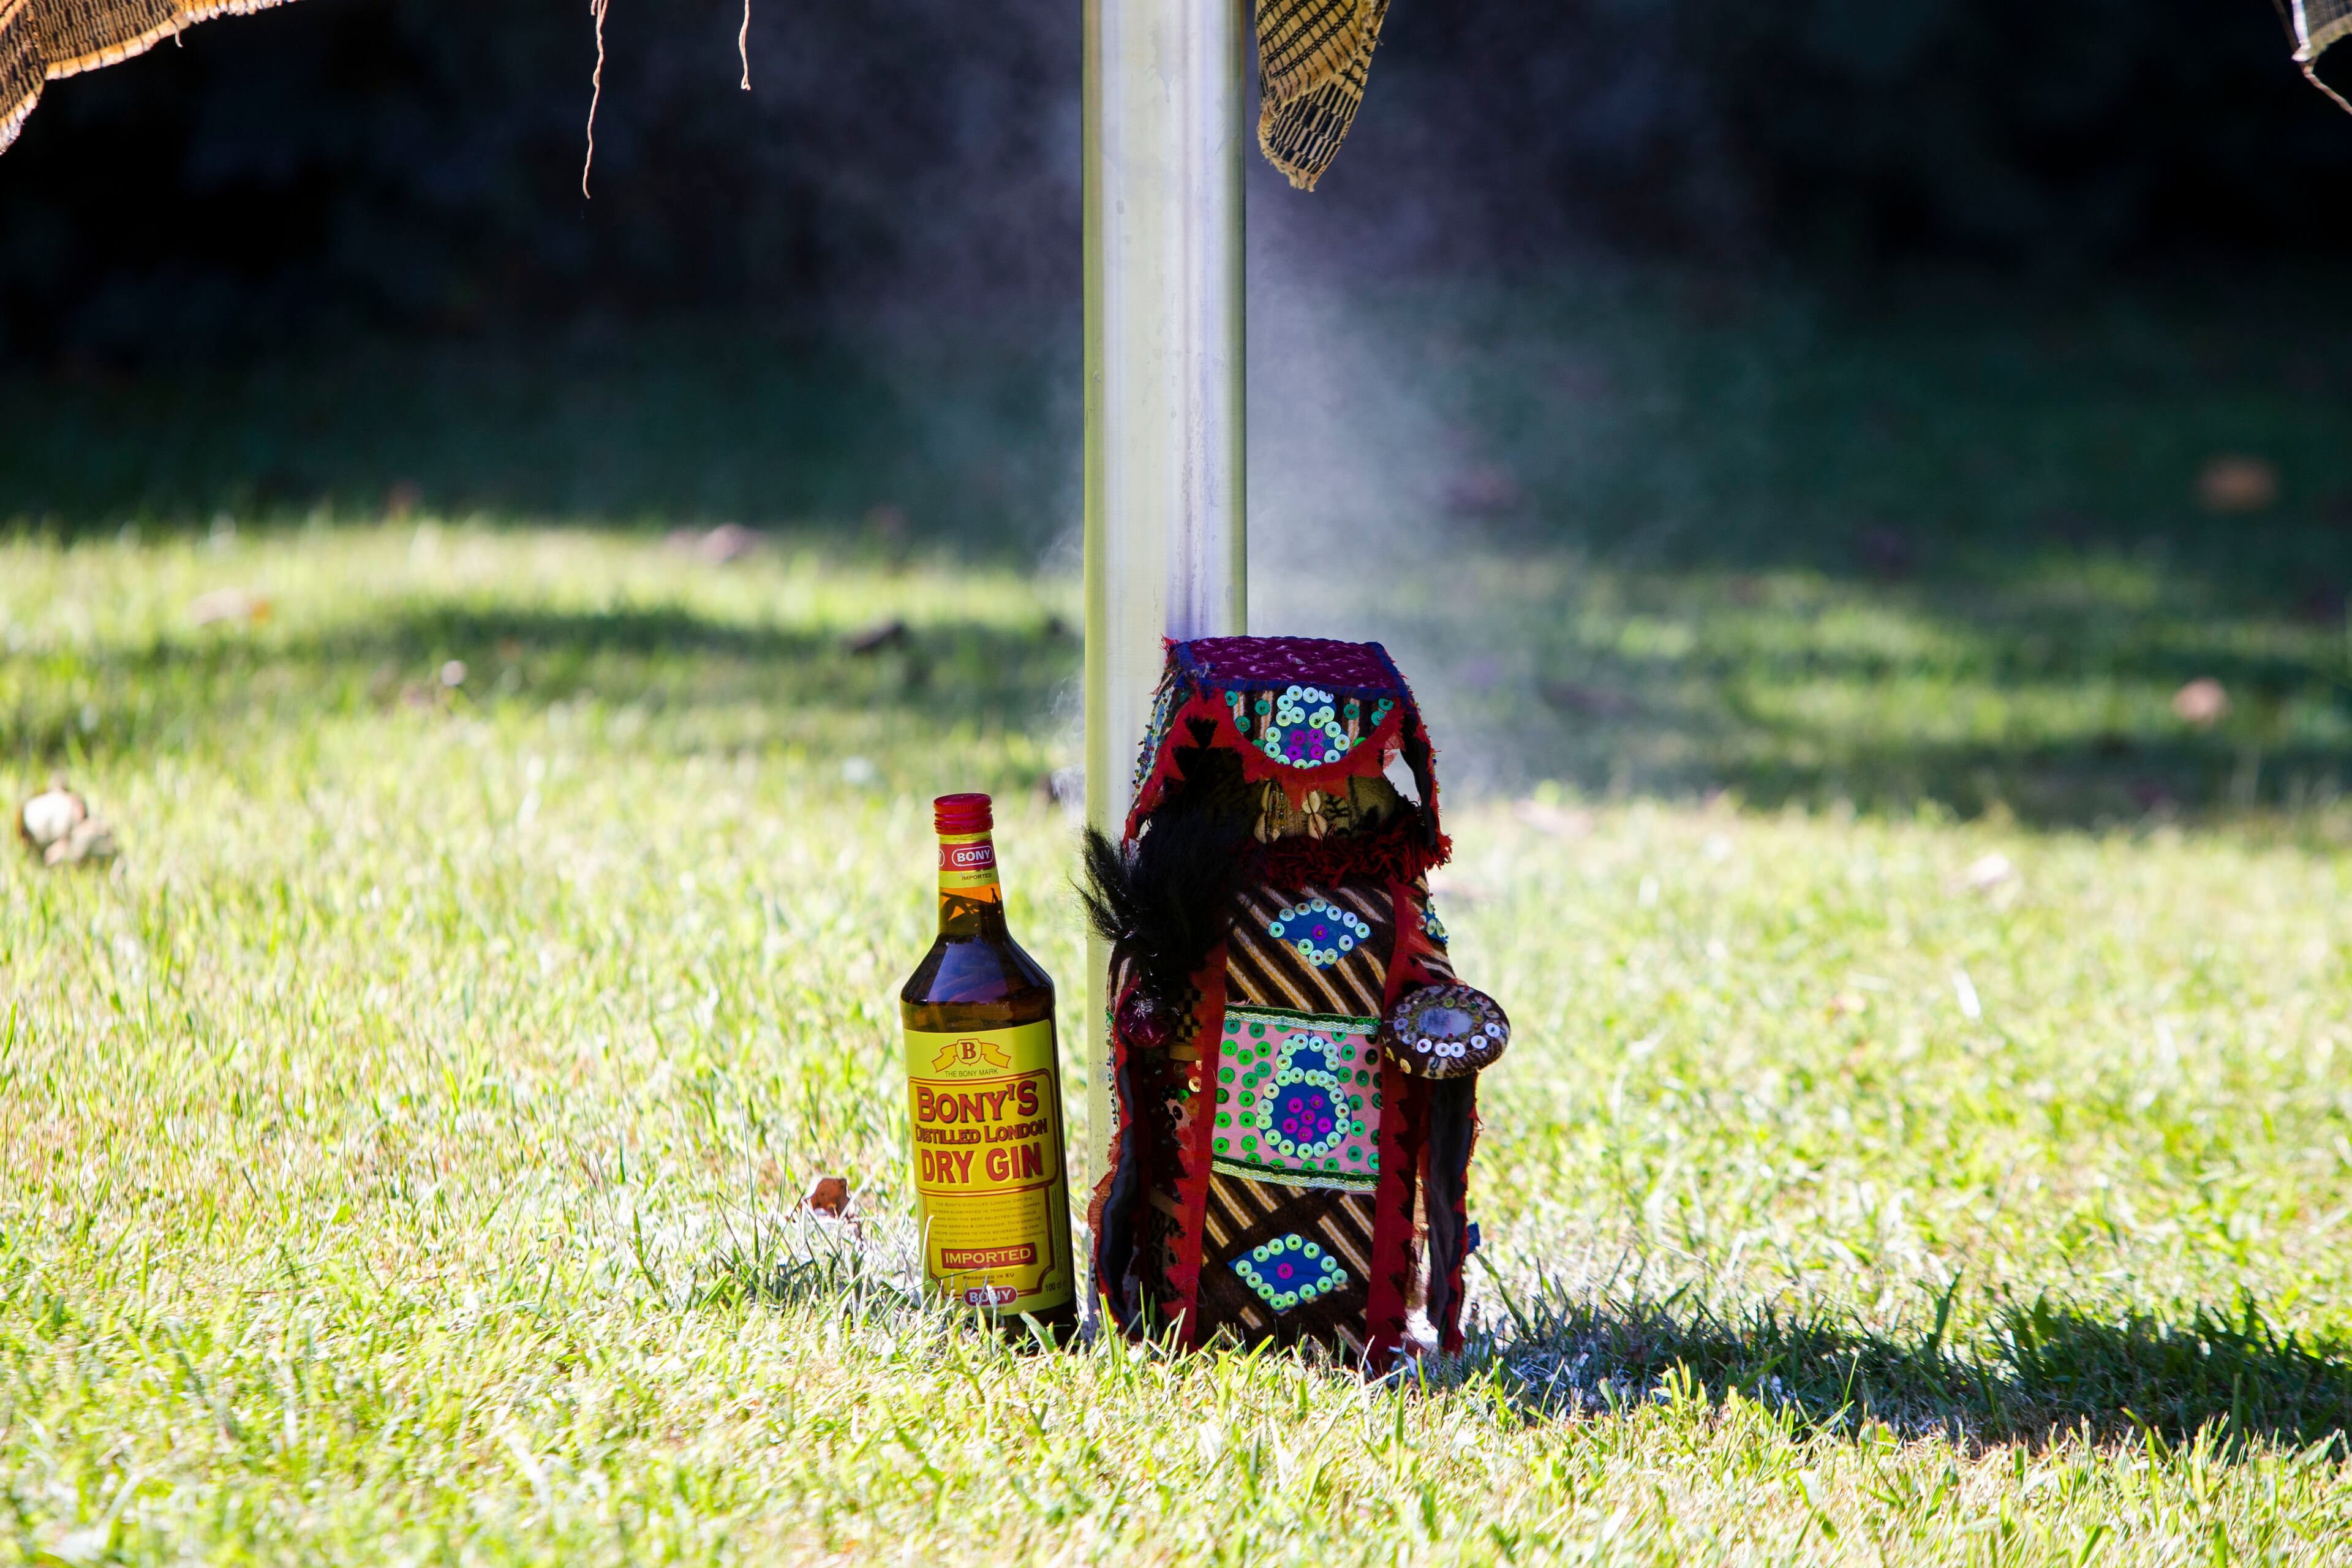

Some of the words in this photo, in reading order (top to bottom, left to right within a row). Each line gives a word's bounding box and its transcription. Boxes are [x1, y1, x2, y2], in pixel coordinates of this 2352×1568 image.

[957, 849, 990, 862] BONY
[960, 1042, 976, 1059] B
[916, 1080, 1039, 1124] BONY'S
[914, 1123, 981, 1145] DISTILLED
[984, 1118, 1048, 1143] LONDON
[921, 1148, 975, 1184] DRY
[986, 1142, 1044, 1182] GIN
[945, 1248, 1031, 1264] IMPORTED
[1045, 1282, 1056, 1293] 100
